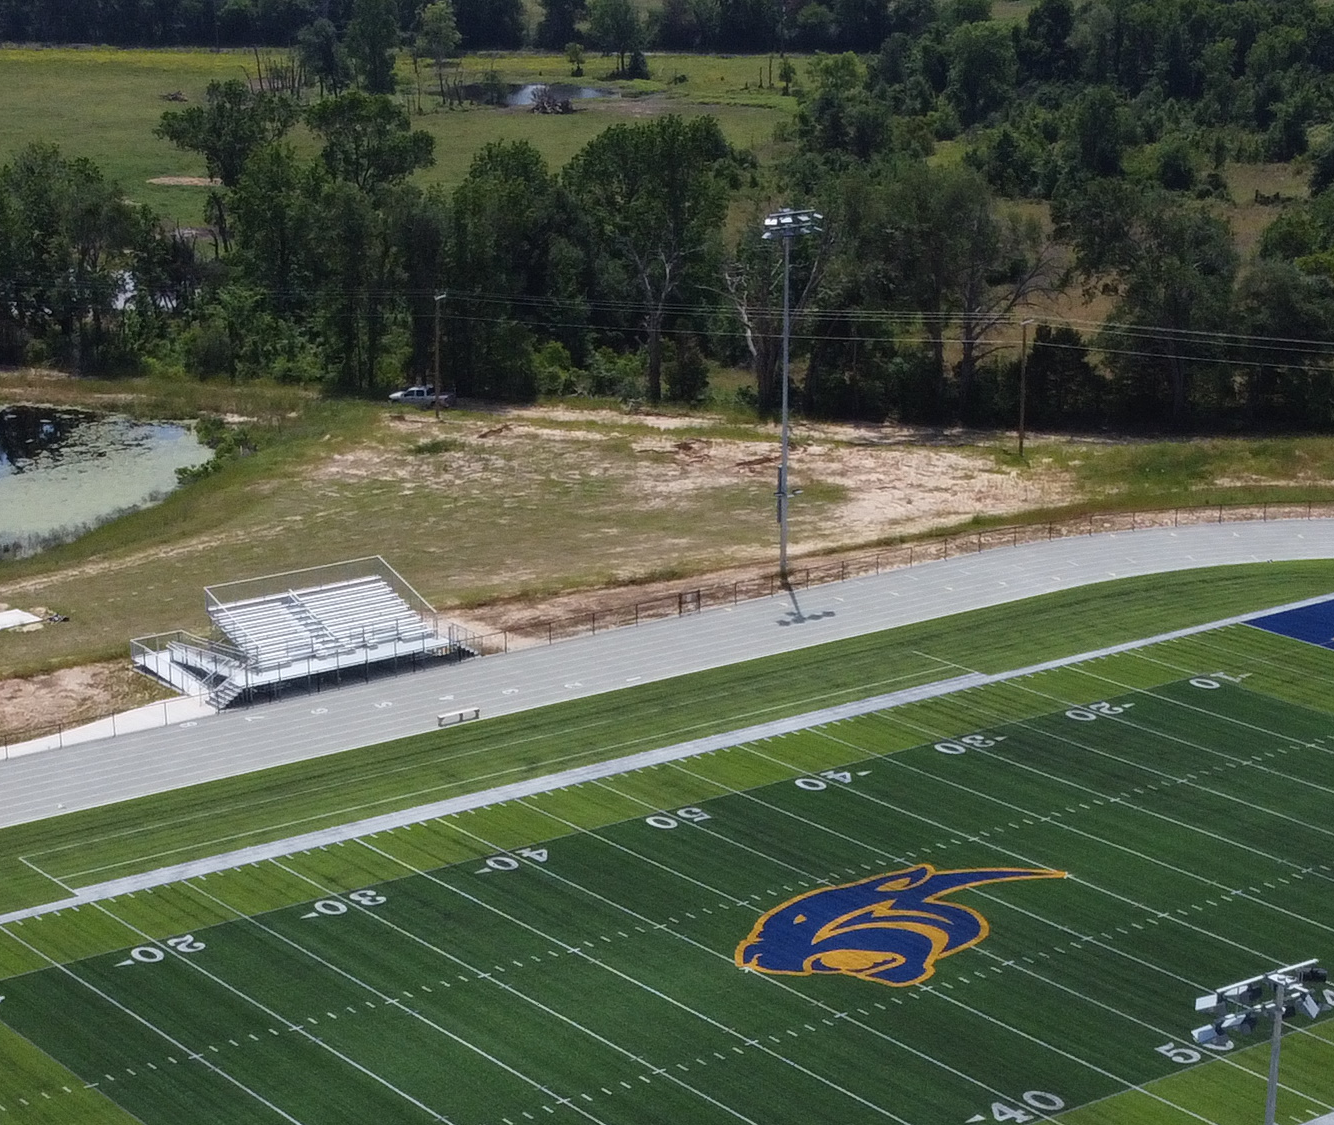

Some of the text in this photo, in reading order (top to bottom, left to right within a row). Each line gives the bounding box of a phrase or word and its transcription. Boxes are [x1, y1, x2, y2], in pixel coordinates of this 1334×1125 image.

[1189, 672, 1244, 690] 10
[1066, 700, 1124, 722] 20
[934, 733, 996, 757] 30
[794, 770, 855, 792] 40
[645, 807, 712, 831] 50
[487, 847, 550, 873] 40
[315, 888, 388, 918] 30
[130, 934, 207, 964] 20
[989, 1089, 1066, 1125] 40
